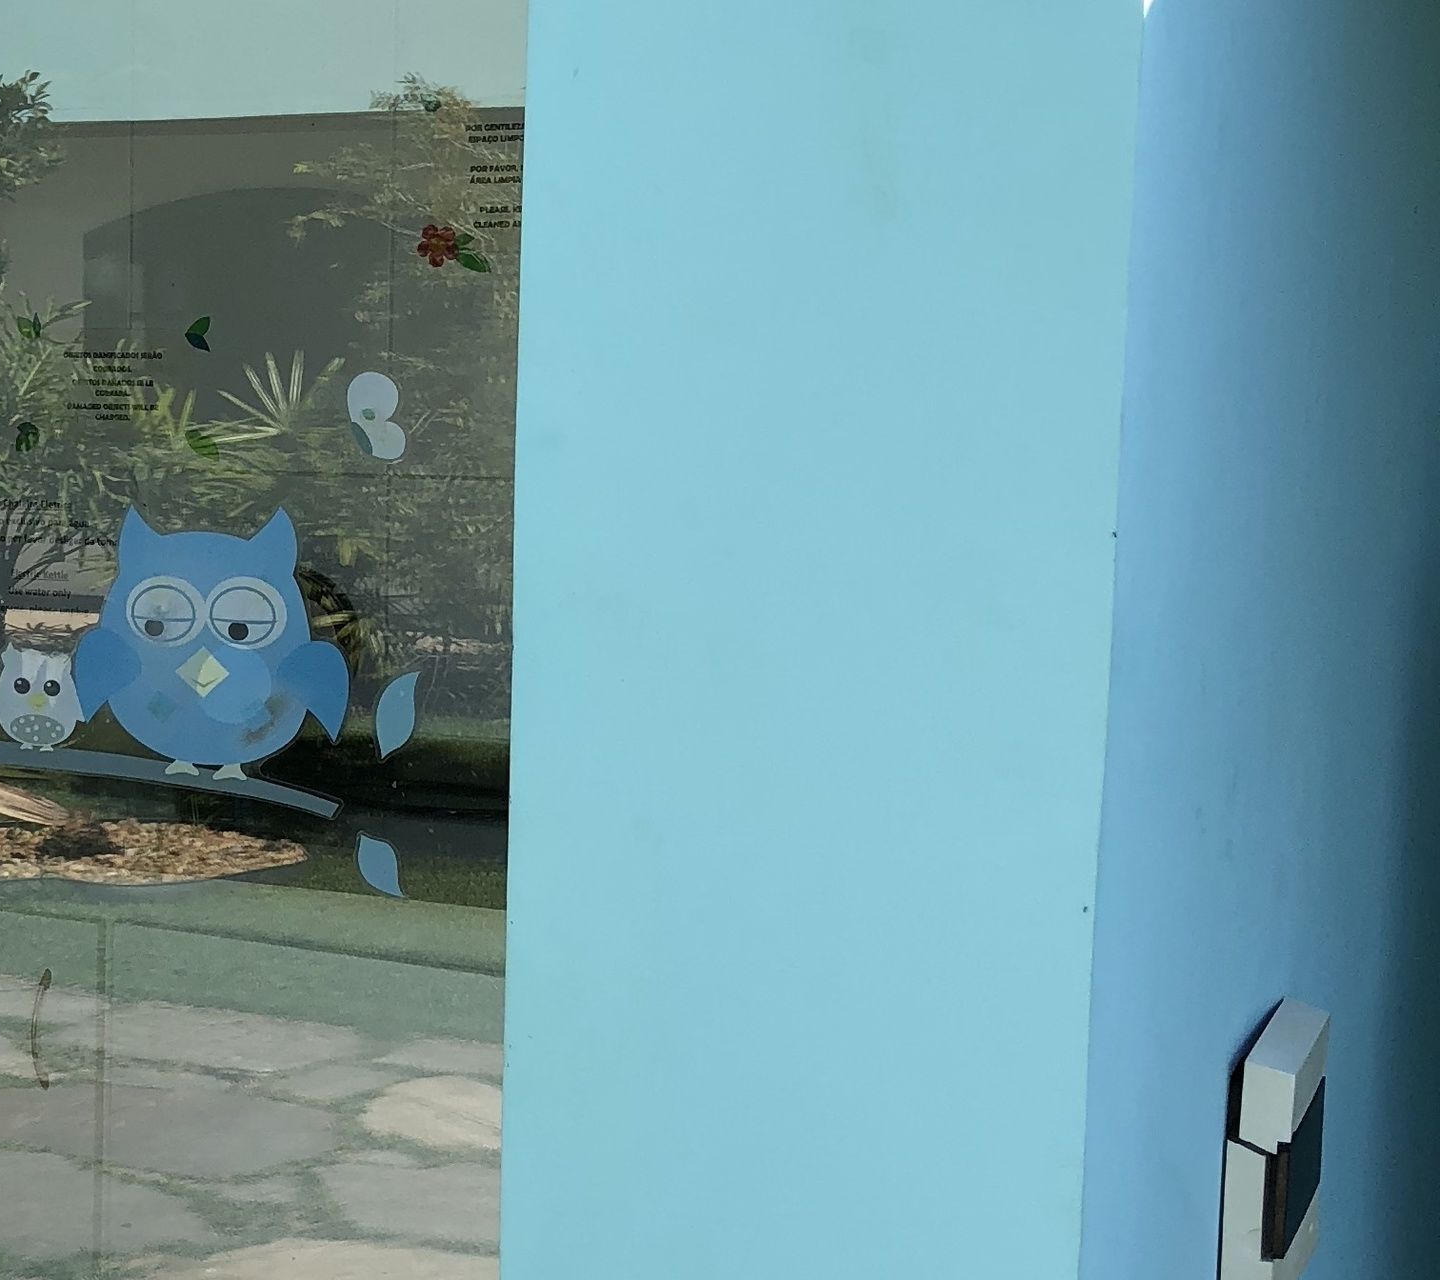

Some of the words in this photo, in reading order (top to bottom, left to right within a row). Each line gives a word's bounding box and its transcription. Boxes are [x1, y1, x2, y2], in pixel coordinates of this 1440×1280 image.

[470, 165, 489, 173] POR
[25, 587, 51, 597] water
[53, 588, 71, 599] only
